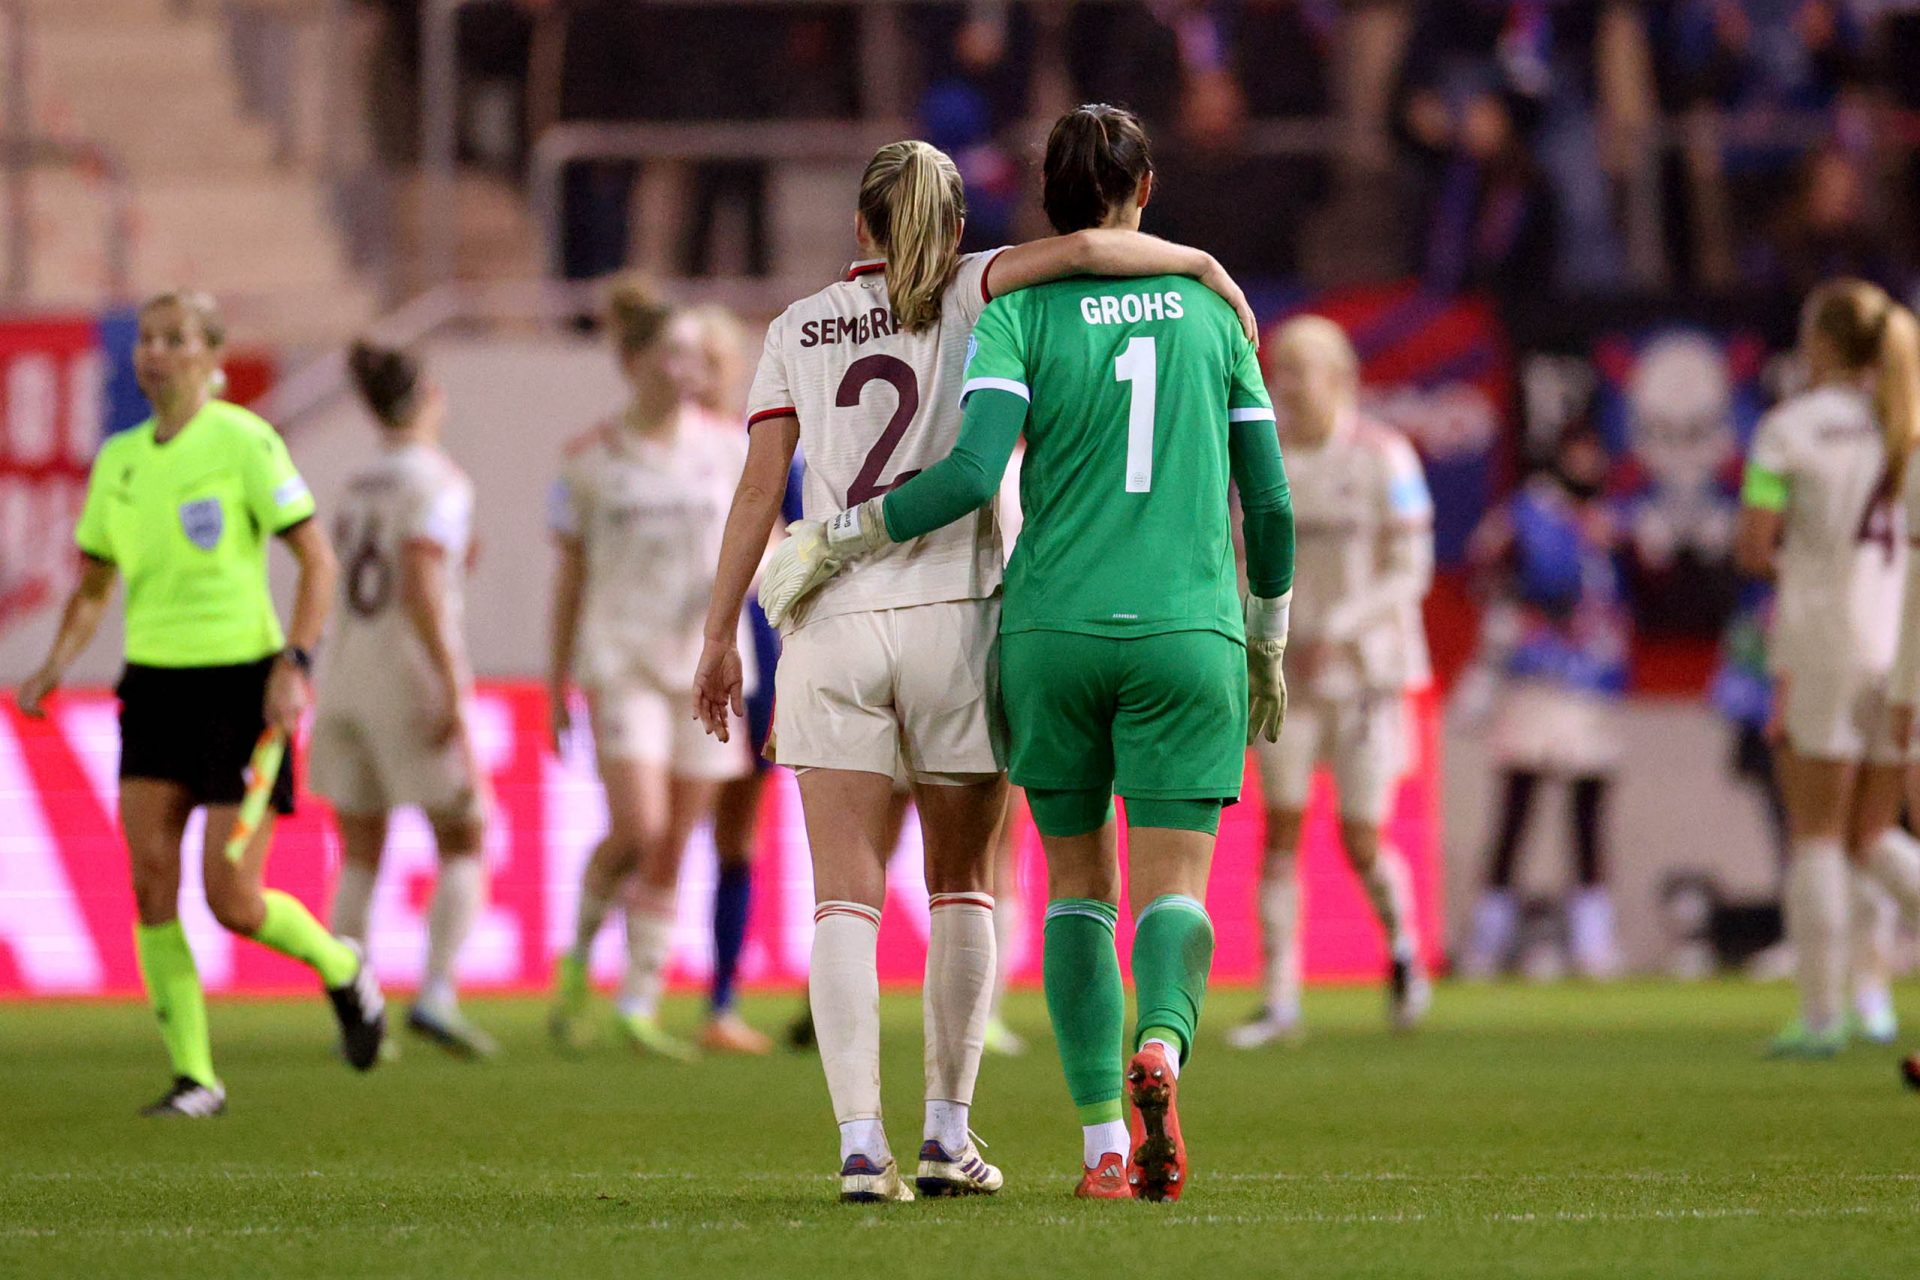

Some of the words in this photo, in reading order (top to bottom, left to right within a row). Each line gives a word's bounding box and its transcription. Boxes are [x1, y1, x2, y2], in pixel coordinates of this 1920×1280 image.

[1080, 291, 1184, 325] GROHS
[835, 354, 922, 509] 2
[1115, 337, 1156, 493] 1
